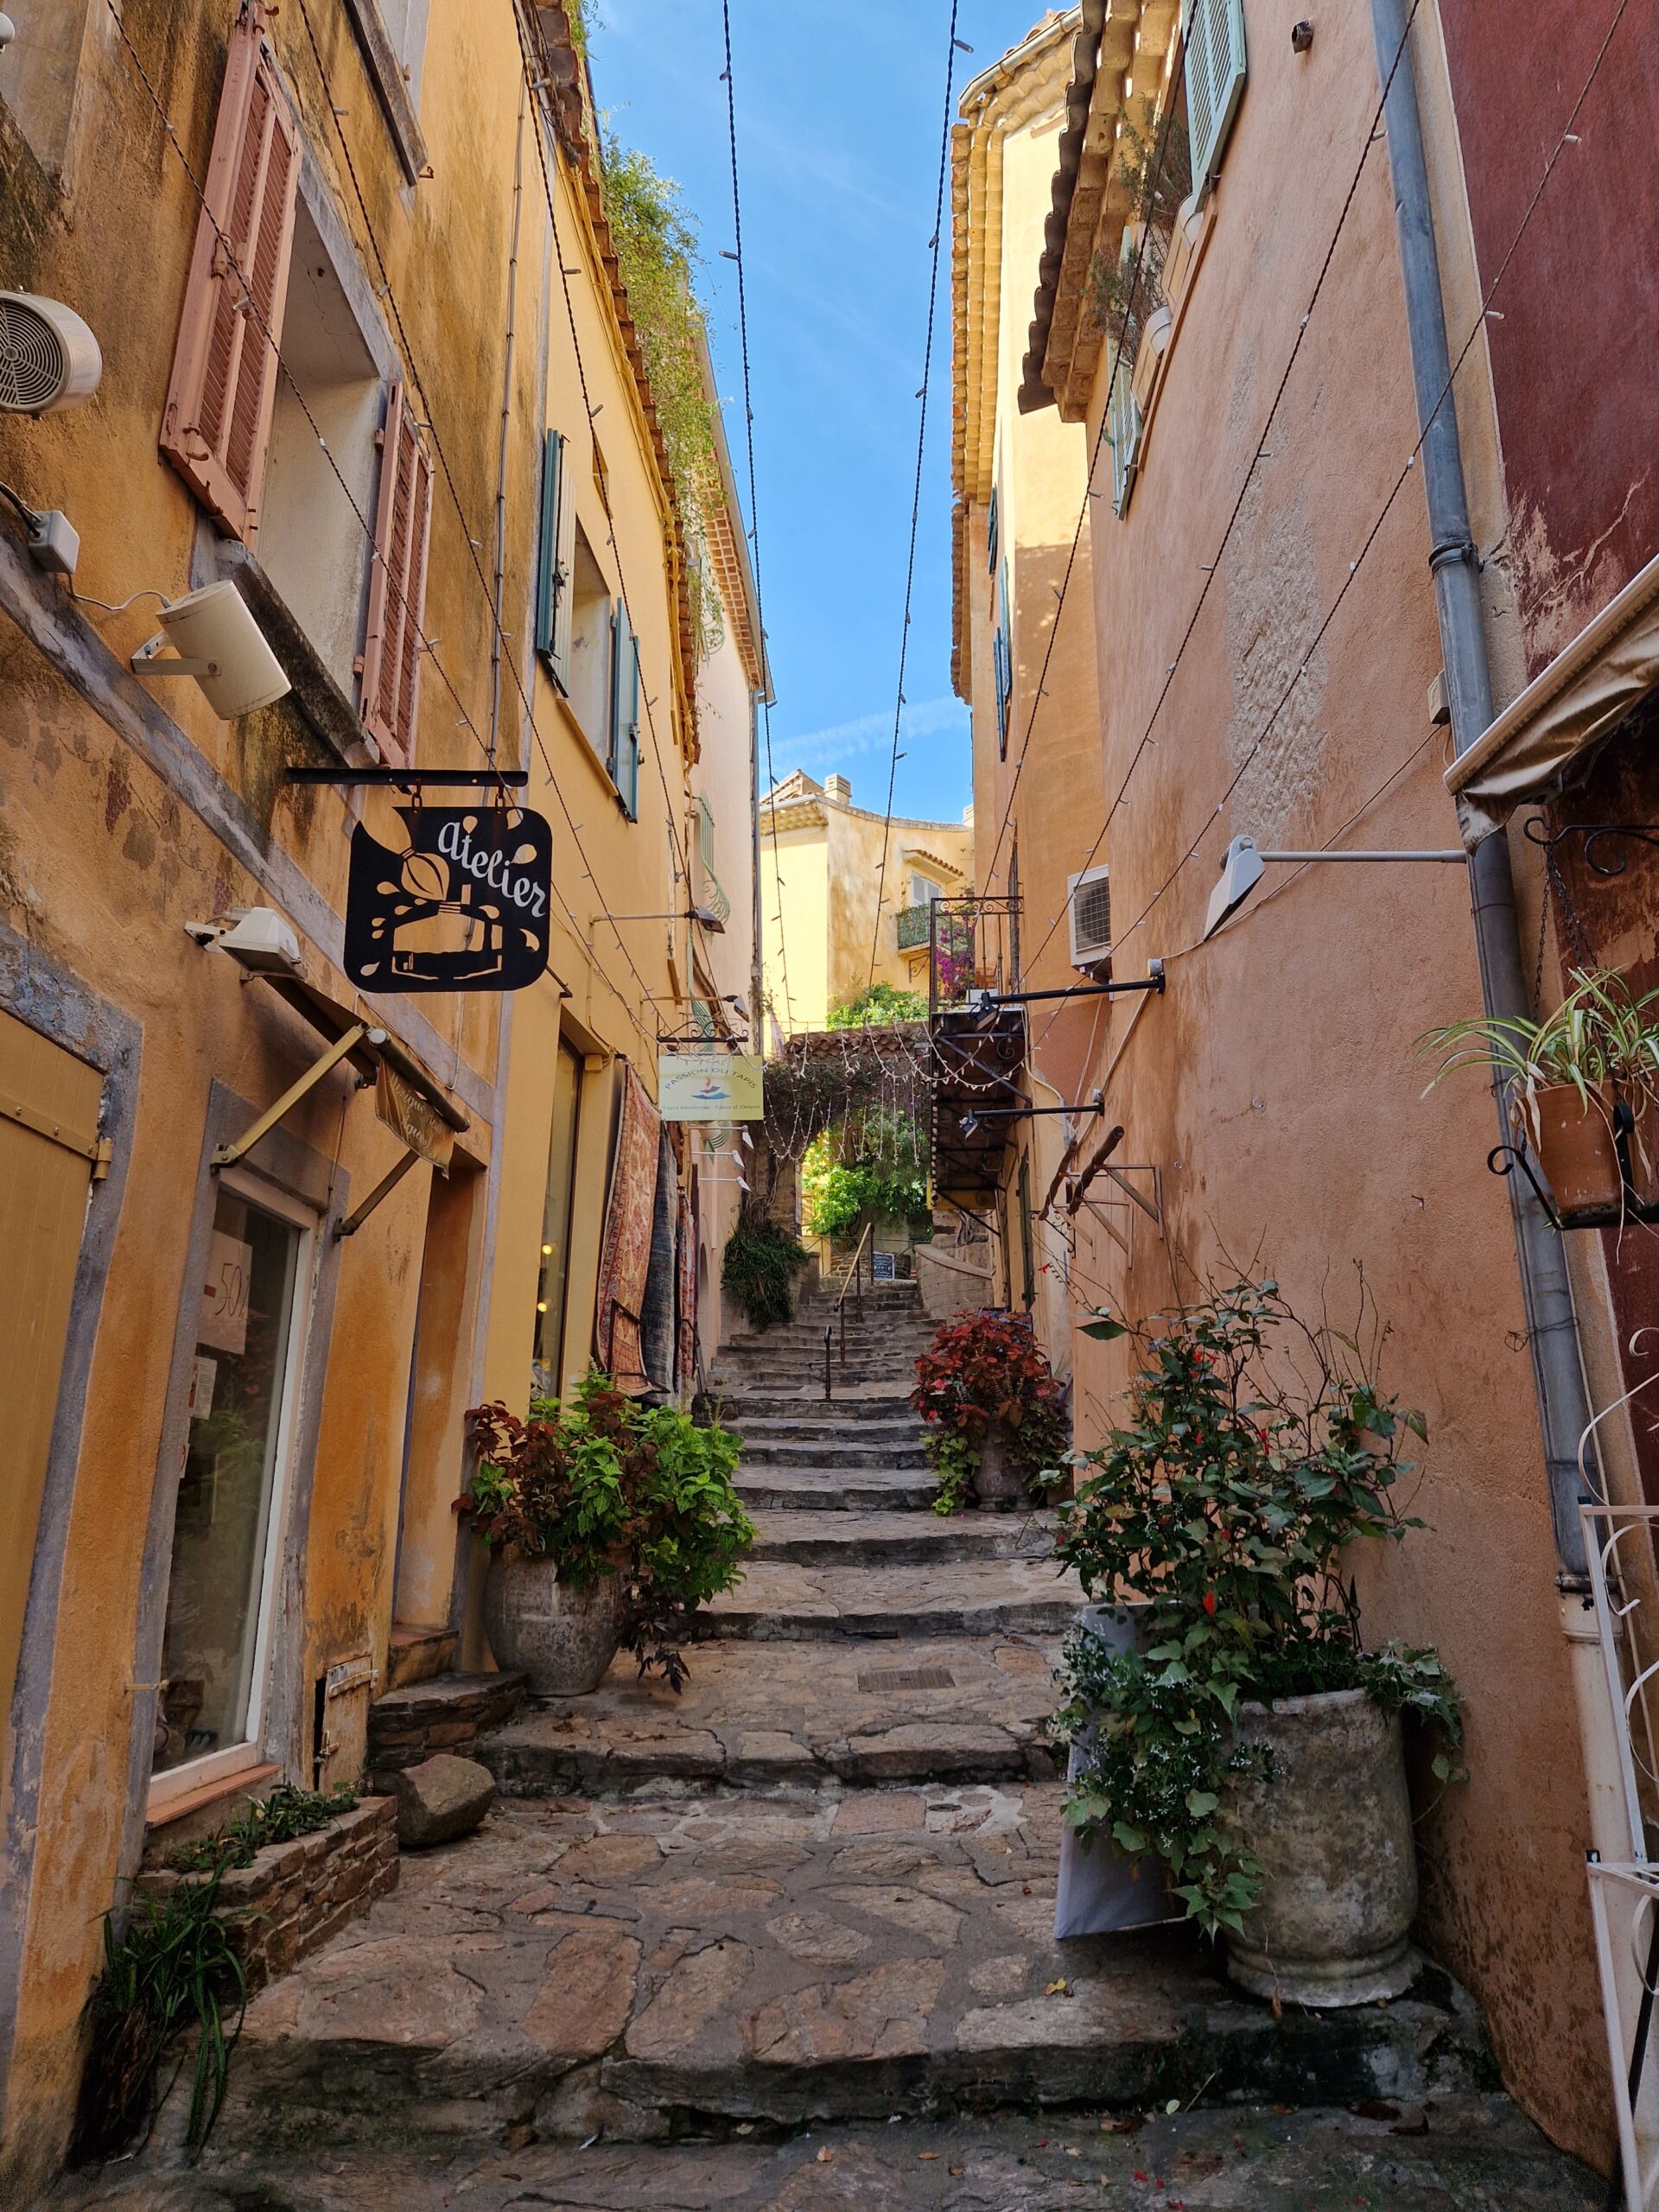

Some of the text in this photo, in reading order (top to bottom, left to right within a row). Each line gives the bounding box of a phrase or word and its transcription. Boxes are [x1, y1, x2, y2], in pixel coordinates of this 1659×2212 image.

[438, 822, 546, 918] atelier
[664, 1067, 708, 1089] PASSION
[732, 1071, 758, 1089] TAPIS
